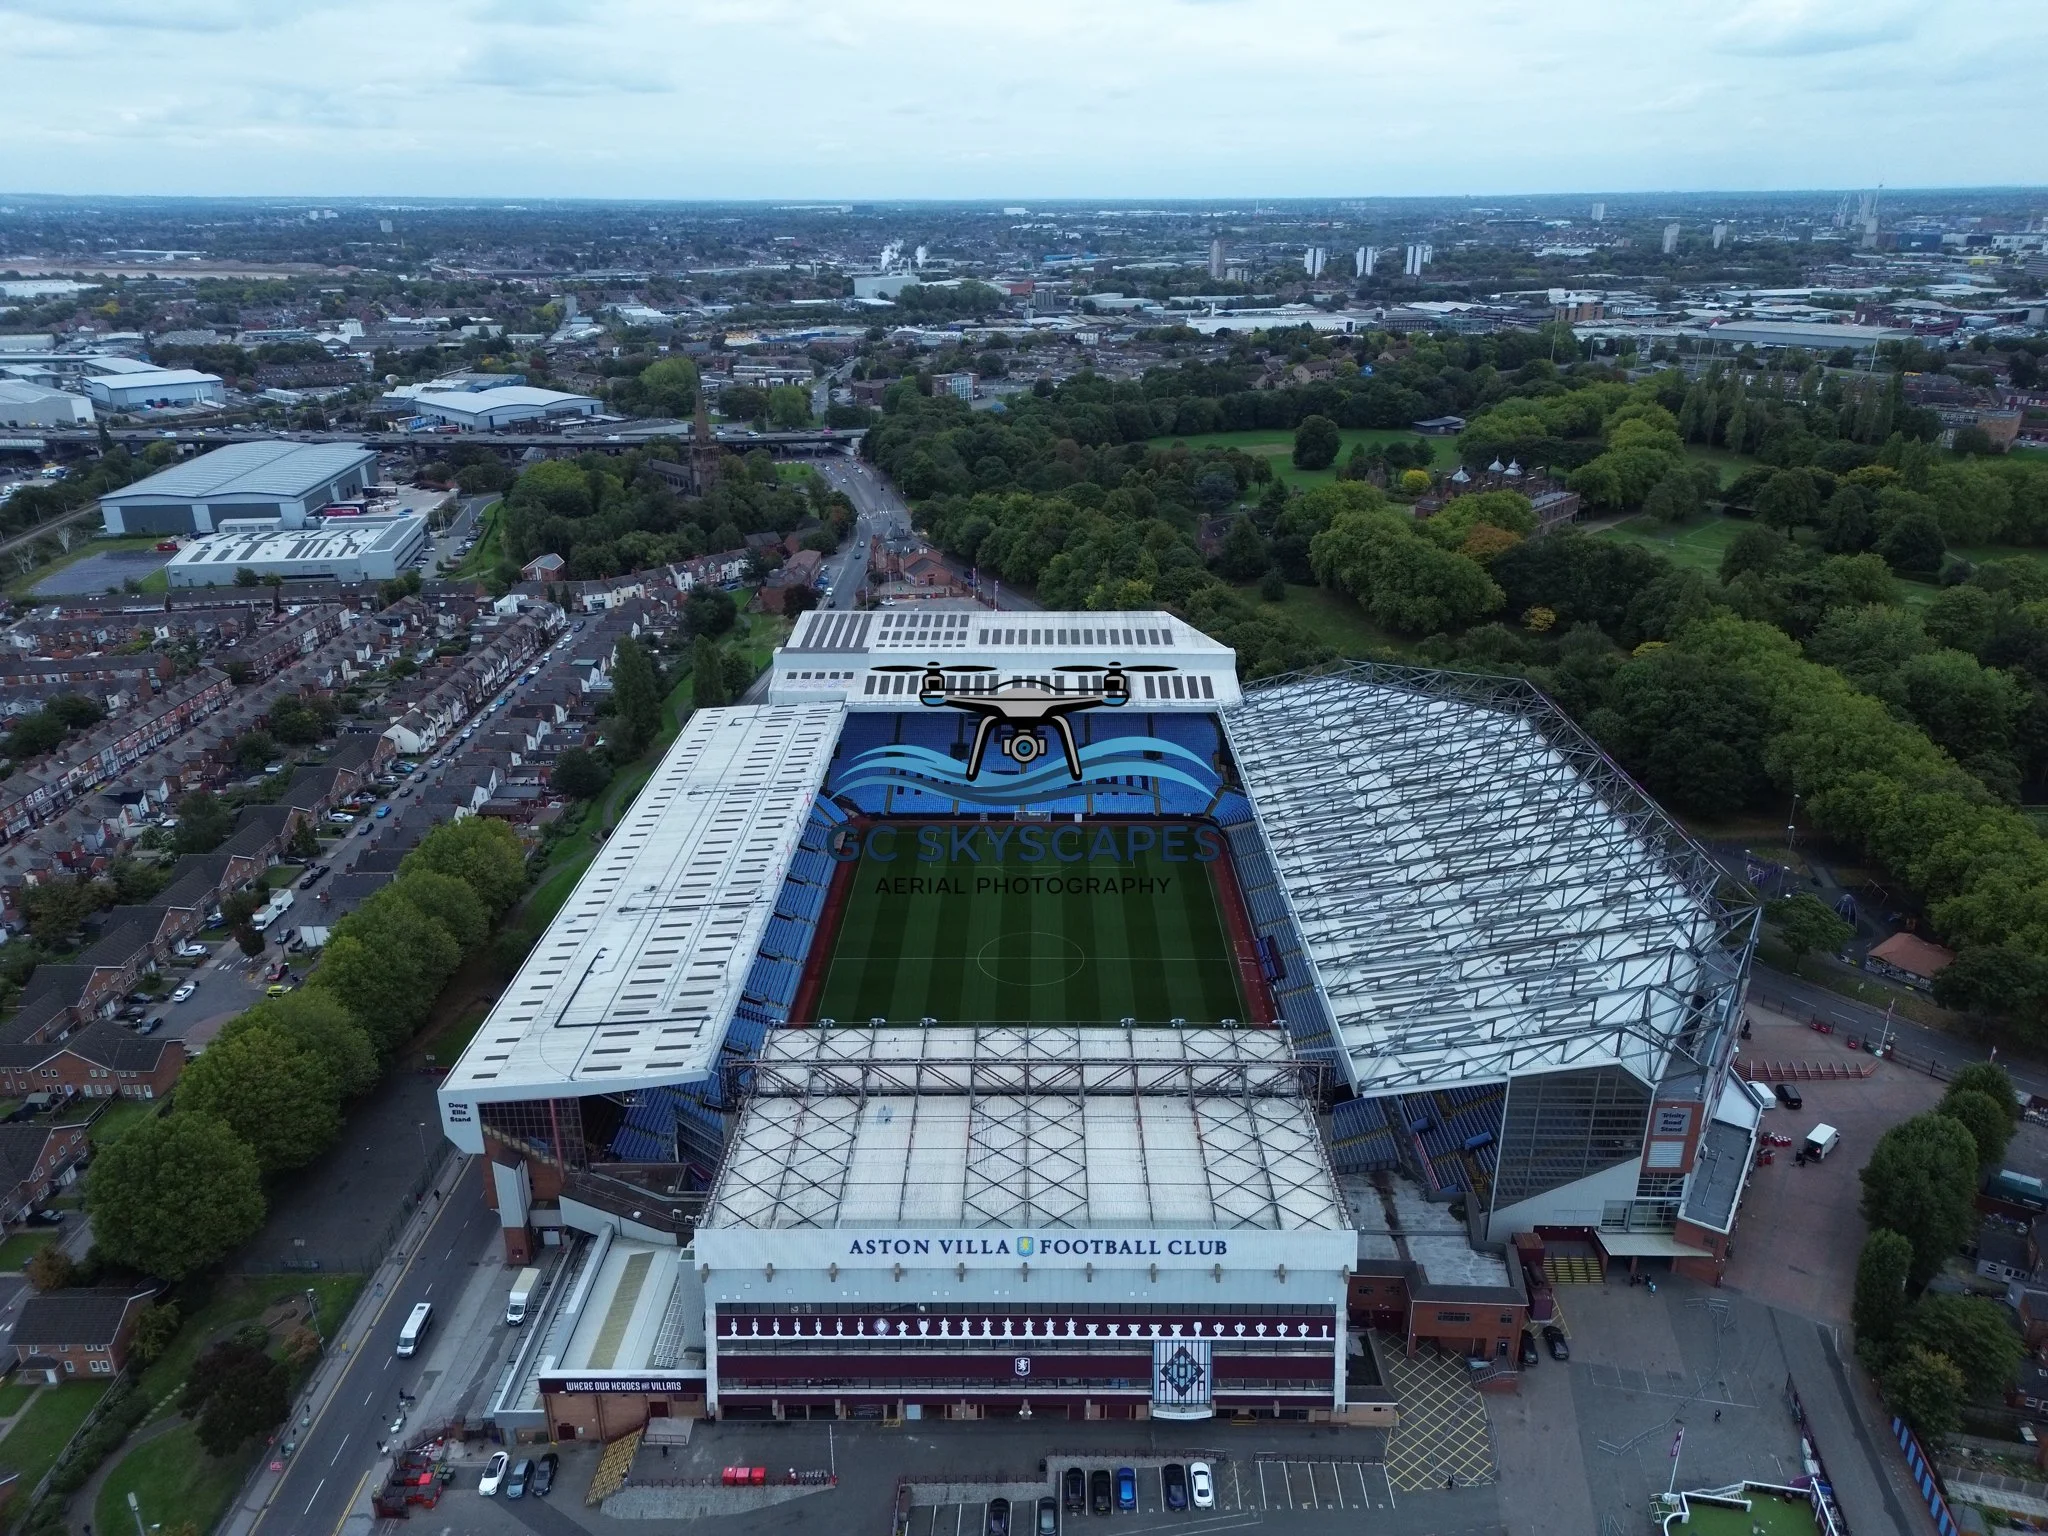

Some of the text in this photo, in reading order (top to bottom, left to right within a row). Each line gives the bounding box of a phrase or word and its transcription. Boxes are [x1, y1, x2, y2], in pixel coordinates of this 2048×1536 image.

[849, 1239, 1227, 1255] ASTON VILLA FOOTBALL CLUB
[566, 1381, 594, 1391] WHERE
[594, 1381, 610, 1391] OUR
[611, 1381, 641, 1391] HEROES
[651, 1381, 682, 1391] VILLANS
